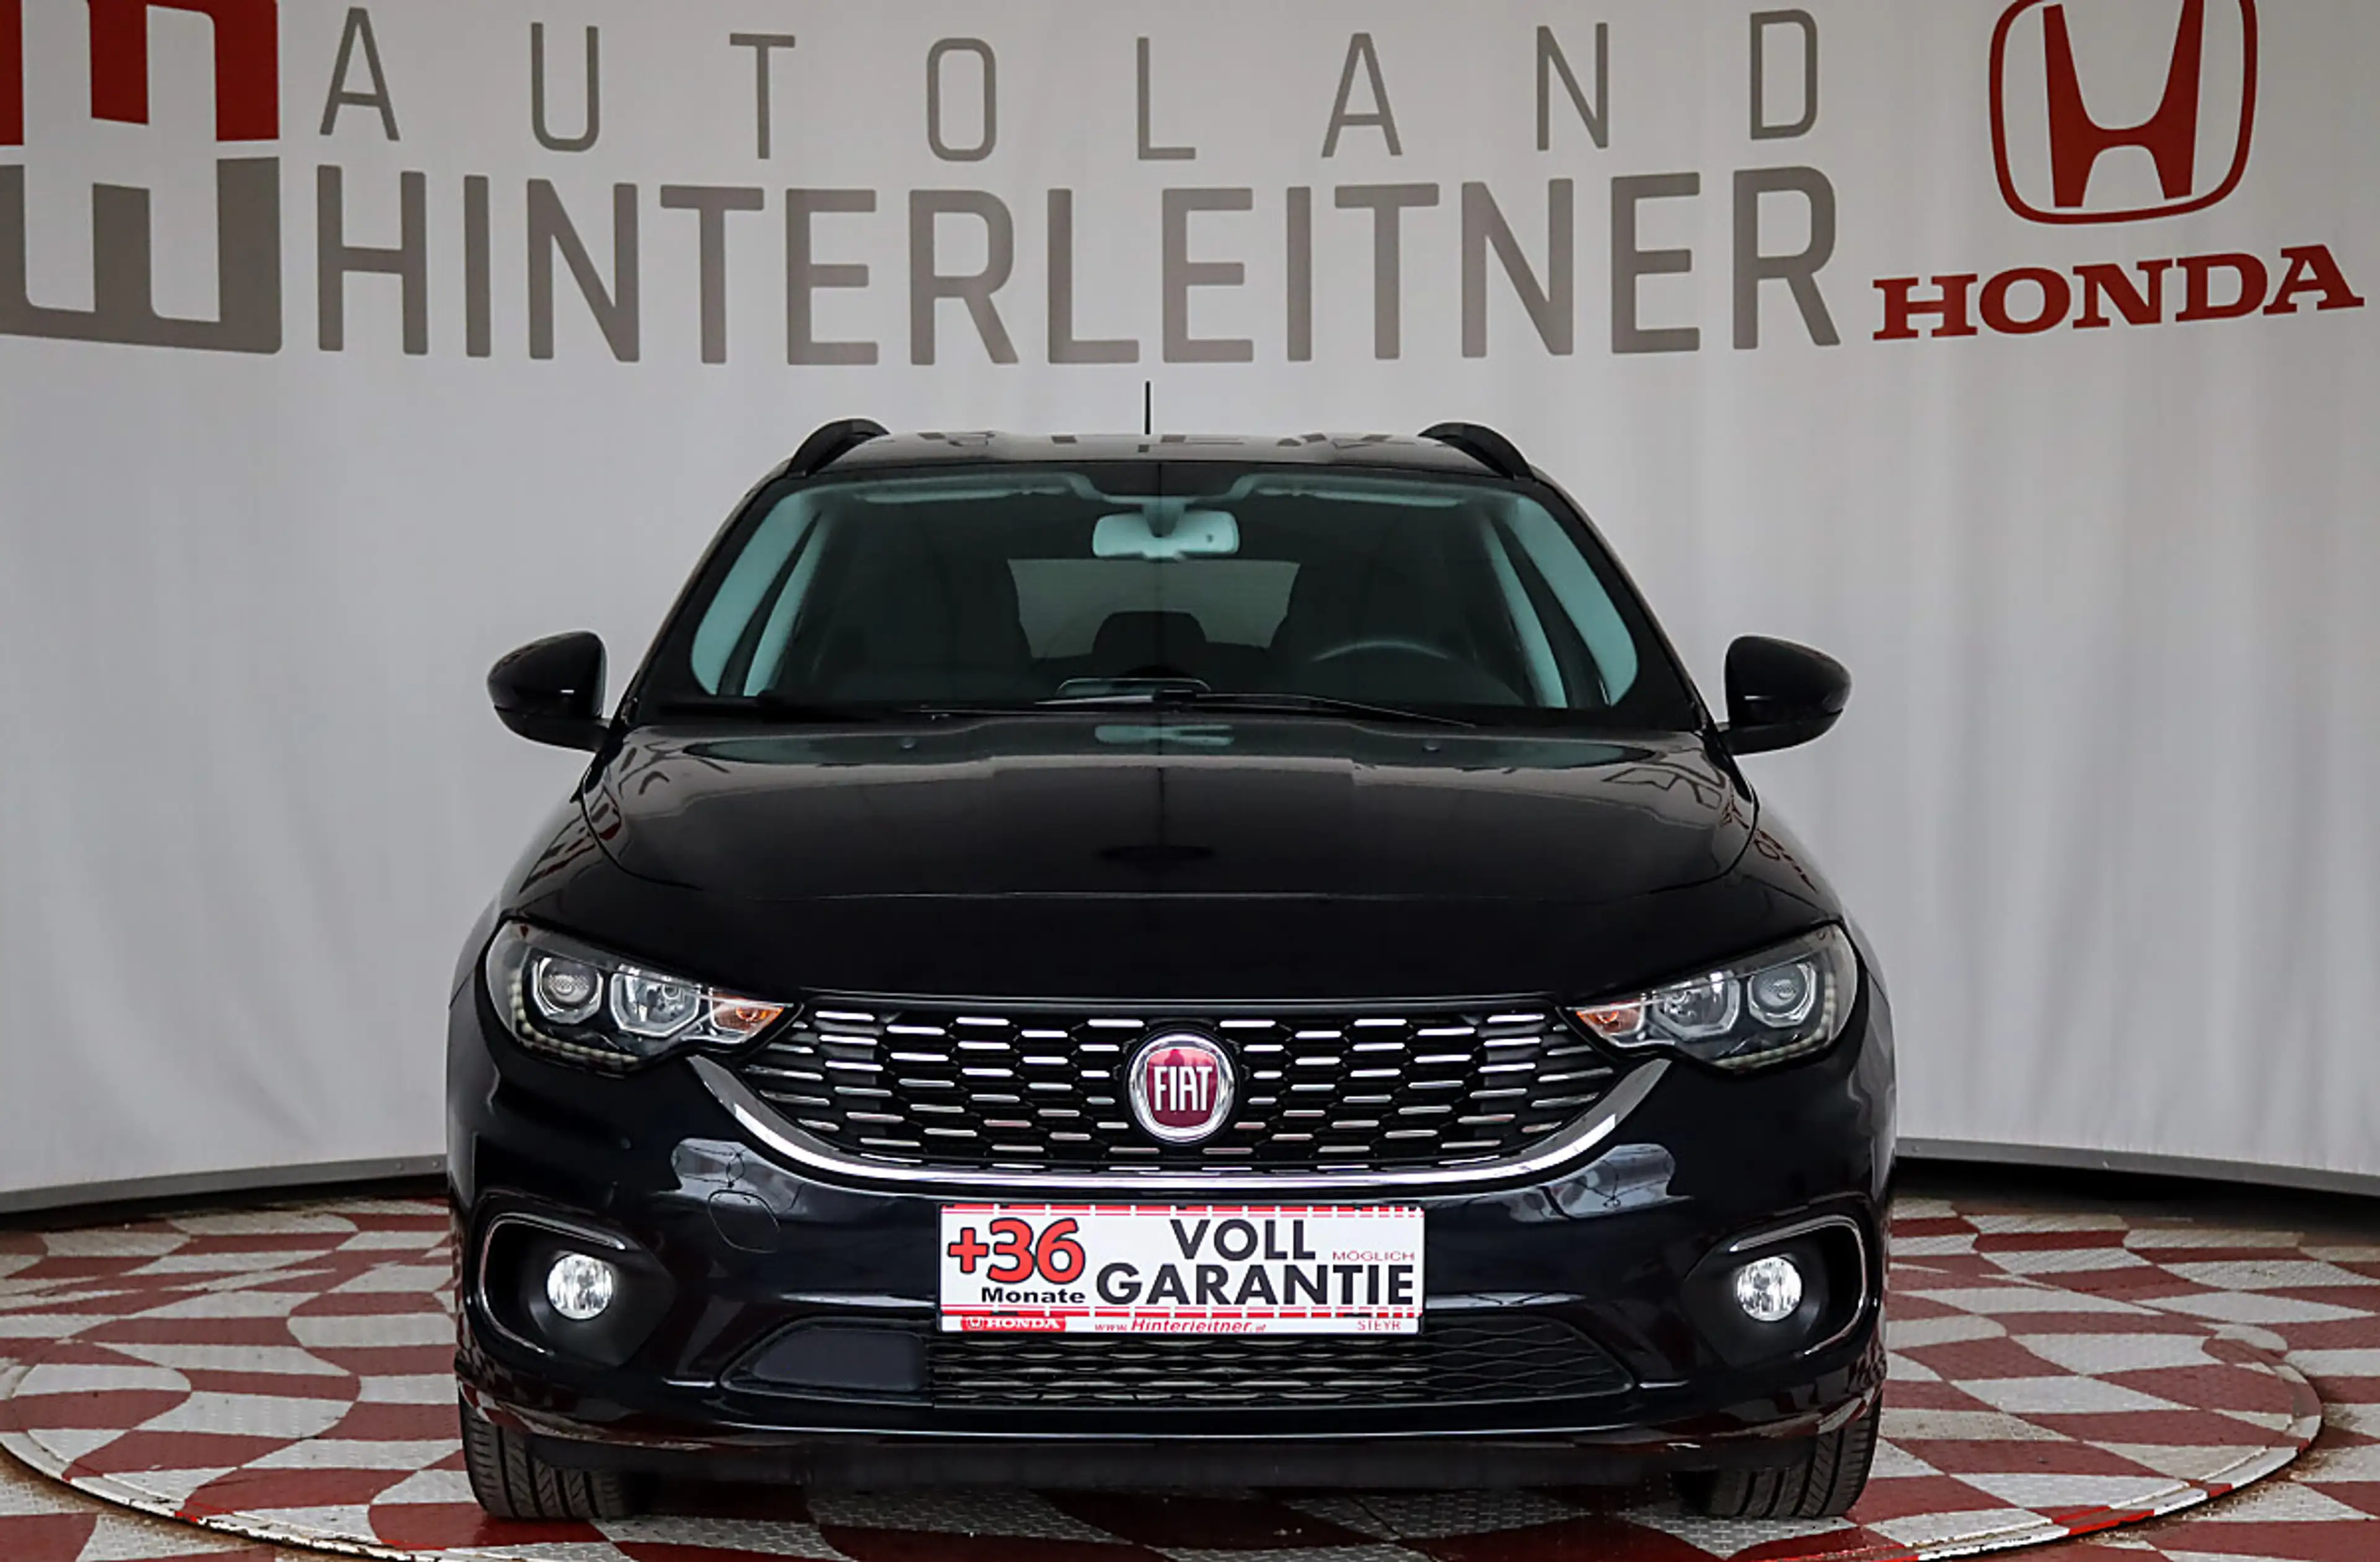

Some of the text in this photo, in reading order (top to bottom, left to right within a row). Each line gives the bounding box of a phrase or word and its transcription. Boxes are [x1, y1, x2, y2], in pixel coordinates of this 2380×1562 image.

[319, 6, 1818, 162] AUTOLAND
[316, 164, 1841, 366] HINTERLEITNER
[1872, 244, 2365, 340] HONDA
[1153, 1066, 1213, 1112] FIAT
[948, 1218, 1085, 1284] +36
[1170, 1219, 1316, 1260] VOLL
[981, 1286, 1086, 1304] Monate
[1096, 1263, 1413, 1305] GARANTIE
[986, 1318, 1060, 1328] HONDA
[1357, 1320, 1401, 1331] STEYR
